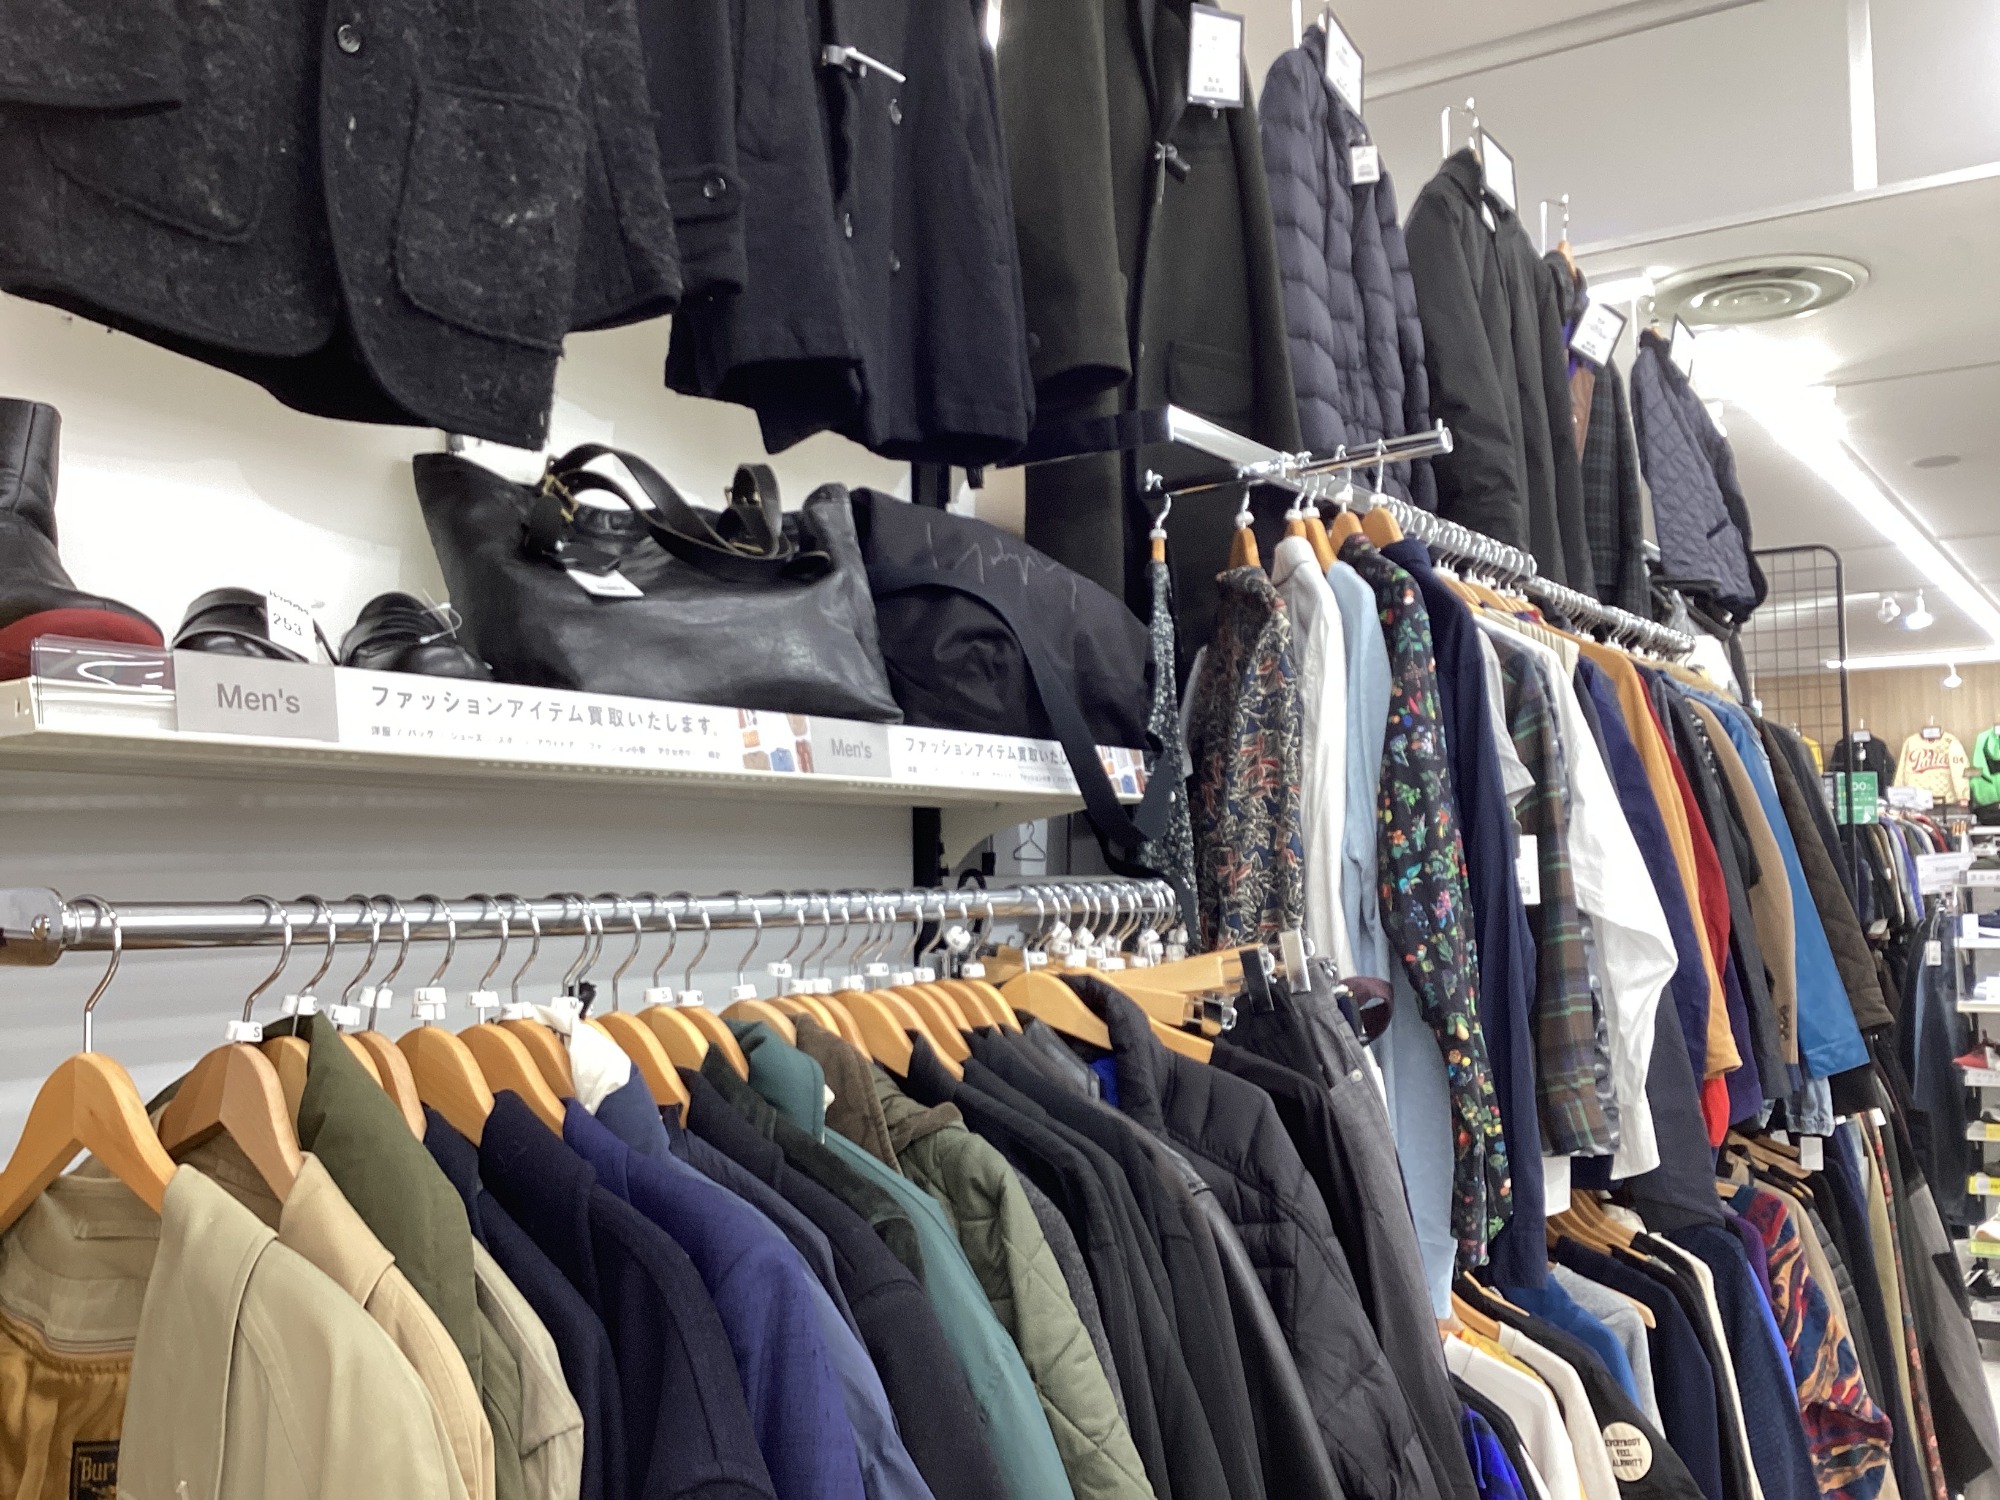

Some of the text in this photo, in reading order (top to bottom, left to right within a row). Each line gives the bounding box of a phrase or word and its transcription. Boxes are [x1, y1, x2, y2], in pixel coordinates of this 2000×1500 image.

[217, 682, 301, 714] Men's
[372, 686, 718, 737] ファッションアイテム買取いたします。
[830, 738, 873, 759] Men's
